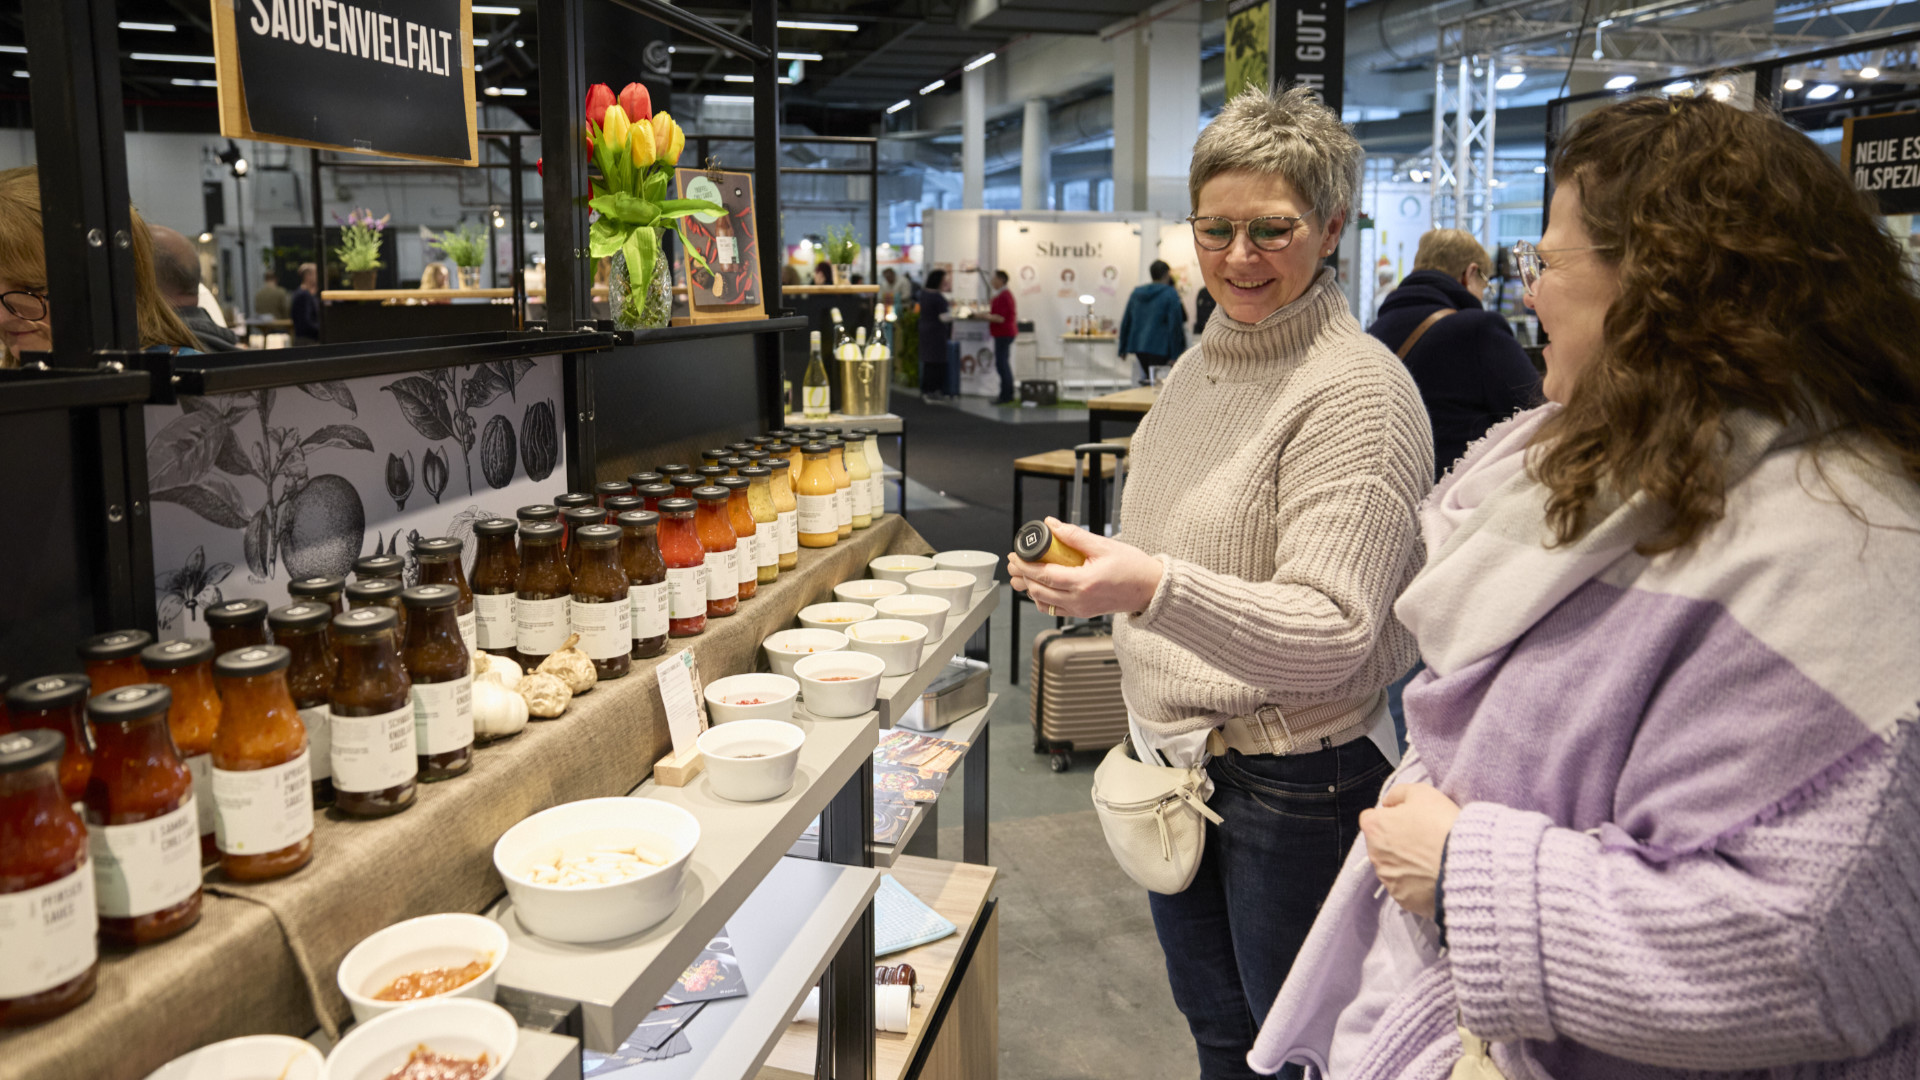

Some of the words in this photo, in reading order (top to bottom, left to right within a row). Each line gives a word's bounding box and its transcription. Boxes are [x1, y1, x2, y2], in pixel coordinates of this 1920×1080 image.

[250, 0, 452, 77] SAUCENVIELFALT
[1296, 2, 1327, 61] GUT.
[1855, 138, 1899, 165] NEUE
[1036, 241, 1103, 259] Shrub!
